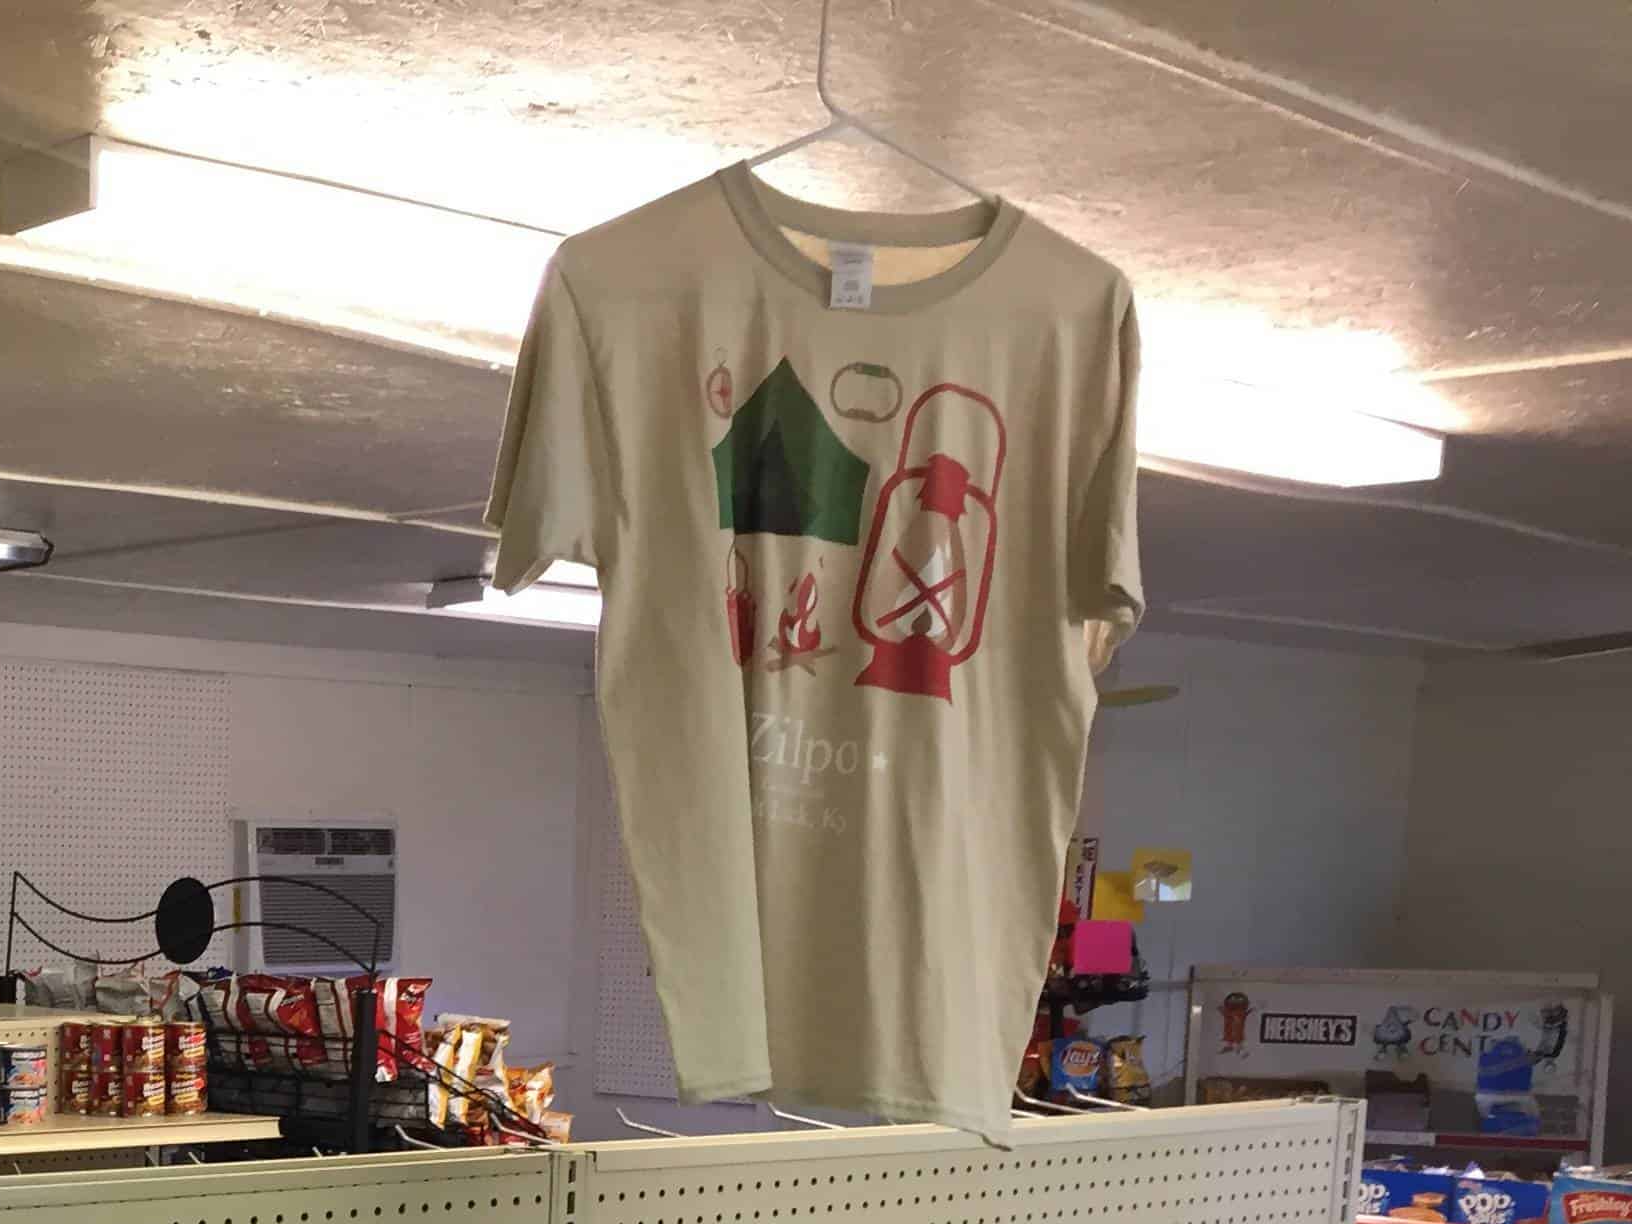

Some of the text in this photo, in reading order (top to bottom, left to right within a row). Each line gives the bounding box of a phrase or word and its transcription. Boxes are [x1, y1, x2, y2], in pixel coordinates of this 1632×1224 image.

[751, 711, 859, 785] Zilpo
[1264, 1016, 1353, 1043] HERSHEY'S
[1424, 1005, 1521, 1034] CANDY
[1420, 1034, 1490, 1057] CENT
